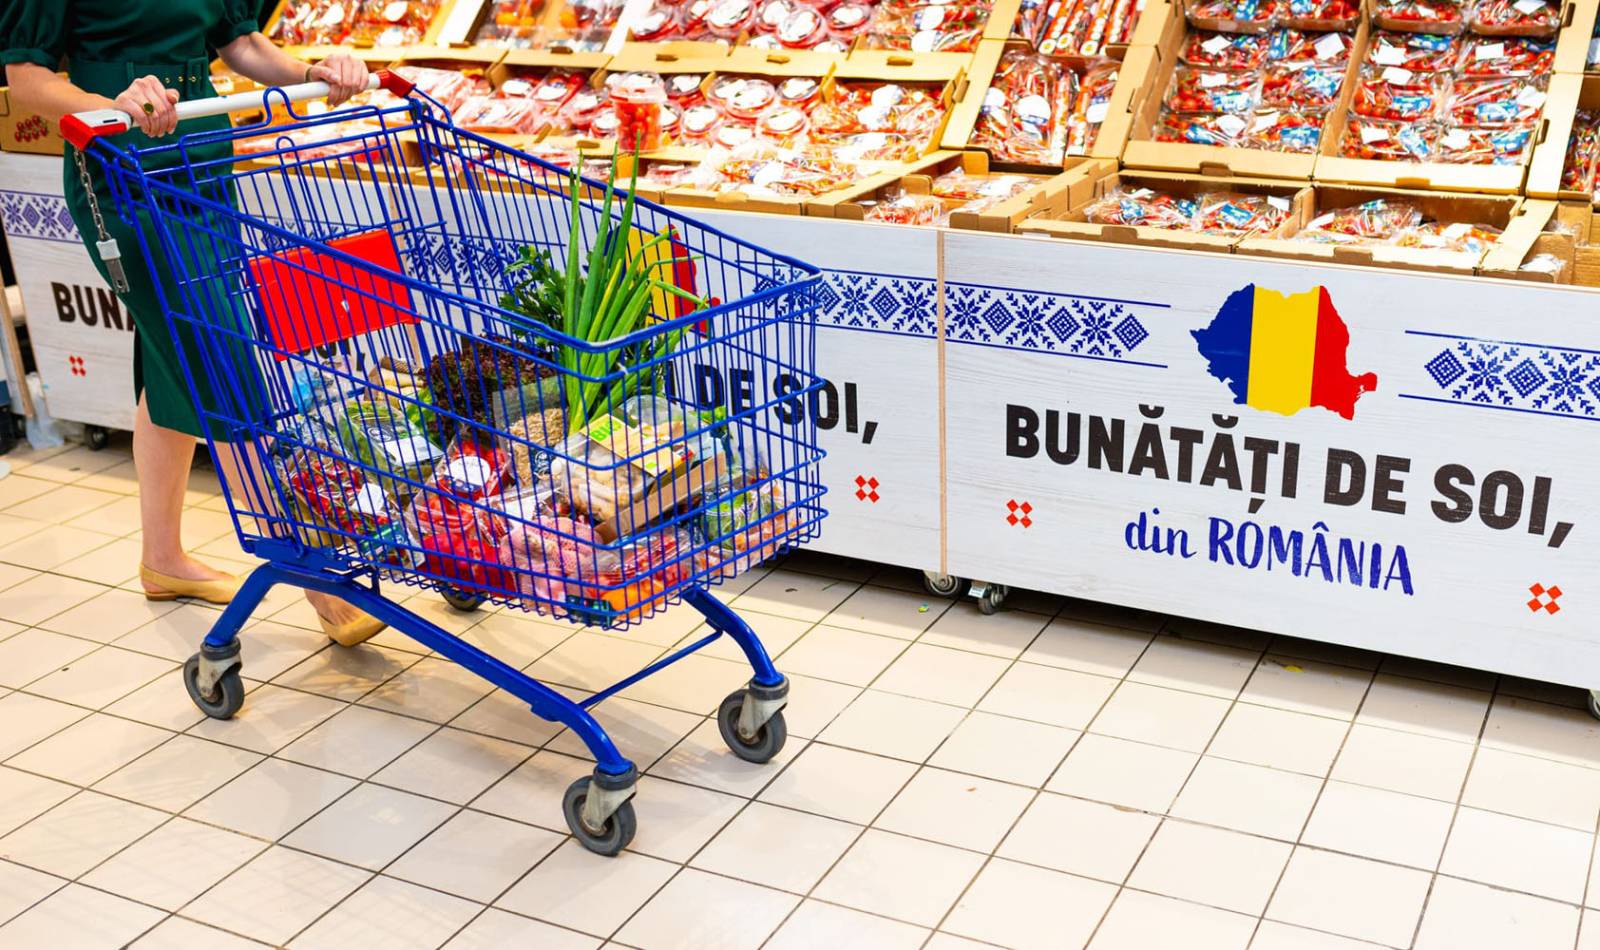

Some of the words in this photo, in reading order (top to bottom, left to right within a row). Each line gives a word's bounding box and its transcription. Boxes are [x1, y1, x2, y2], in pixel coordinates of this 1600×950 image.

[694, 363, 757, 420] DE
[773, 373, 878, 445] SOI,
[1006, 404, 1300, 514] BUNĂTĂȚI
[1324, 448, 1411, 515] DE
[1431, 463, 1574, 549] SOI,
[1124, 508, 1197, 559] din
[1208, 517, 1414, 596] ROMÂNIA
